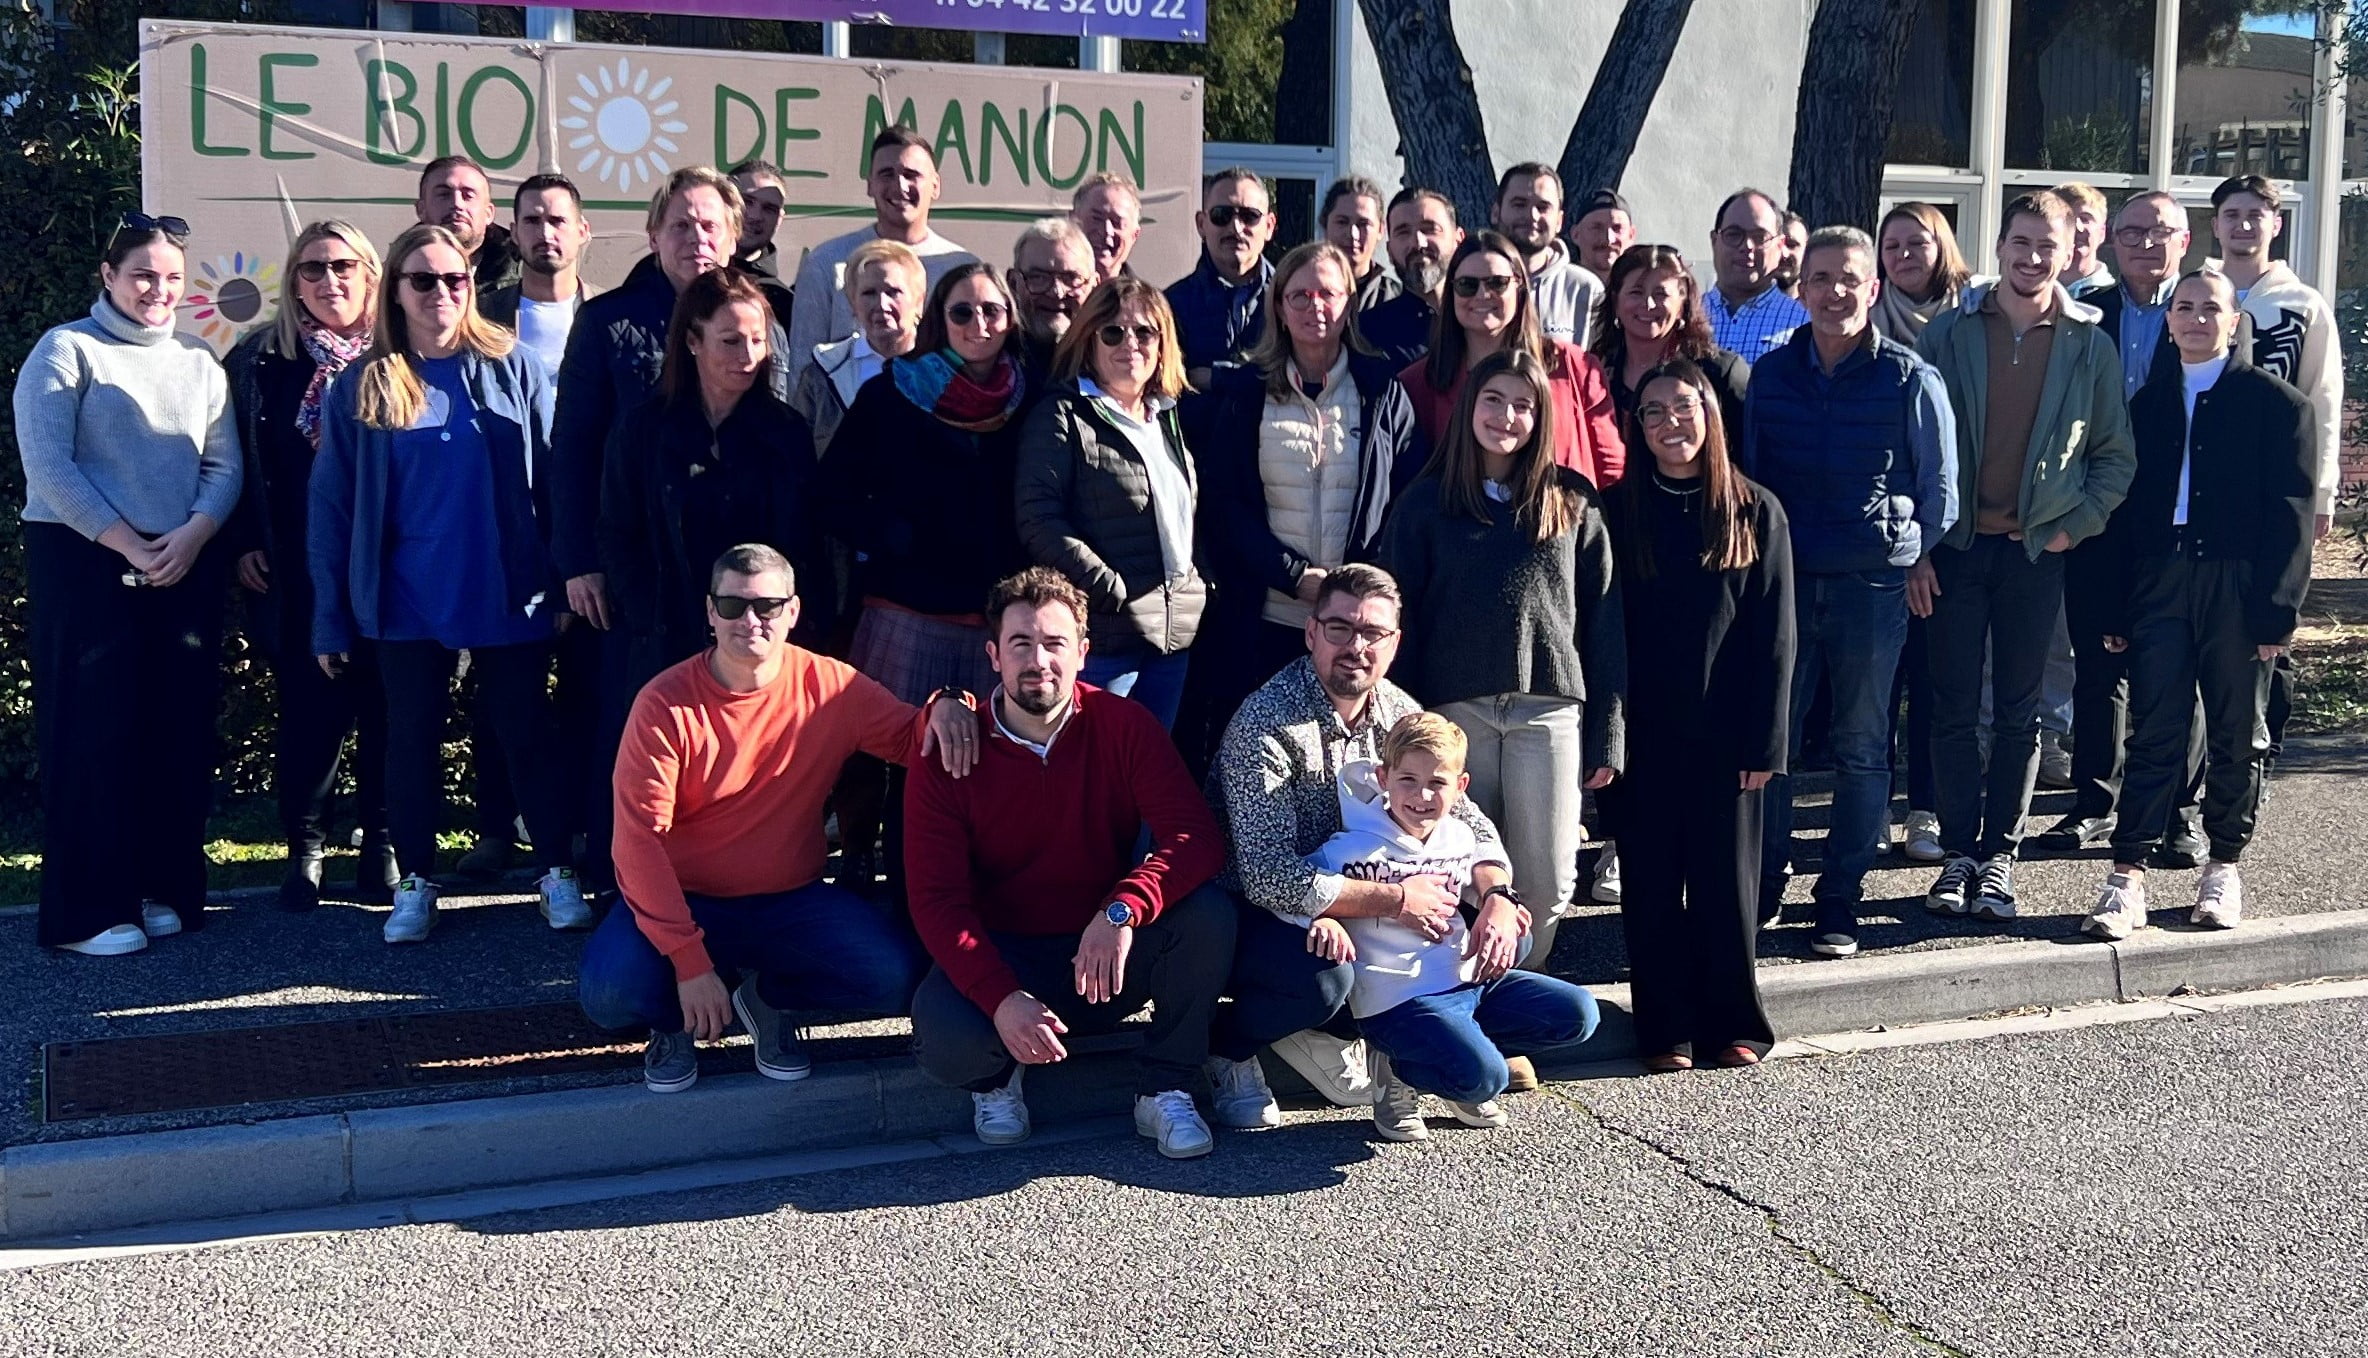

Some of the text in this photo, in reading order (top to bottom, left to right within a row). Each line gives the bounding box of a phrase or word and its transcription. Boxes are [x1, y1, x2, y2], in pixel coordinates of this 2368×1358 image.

[190, 43, 320, 161] LE
[365, 58, 536, 170] BIO
[714, 83, 829, 178] DE
